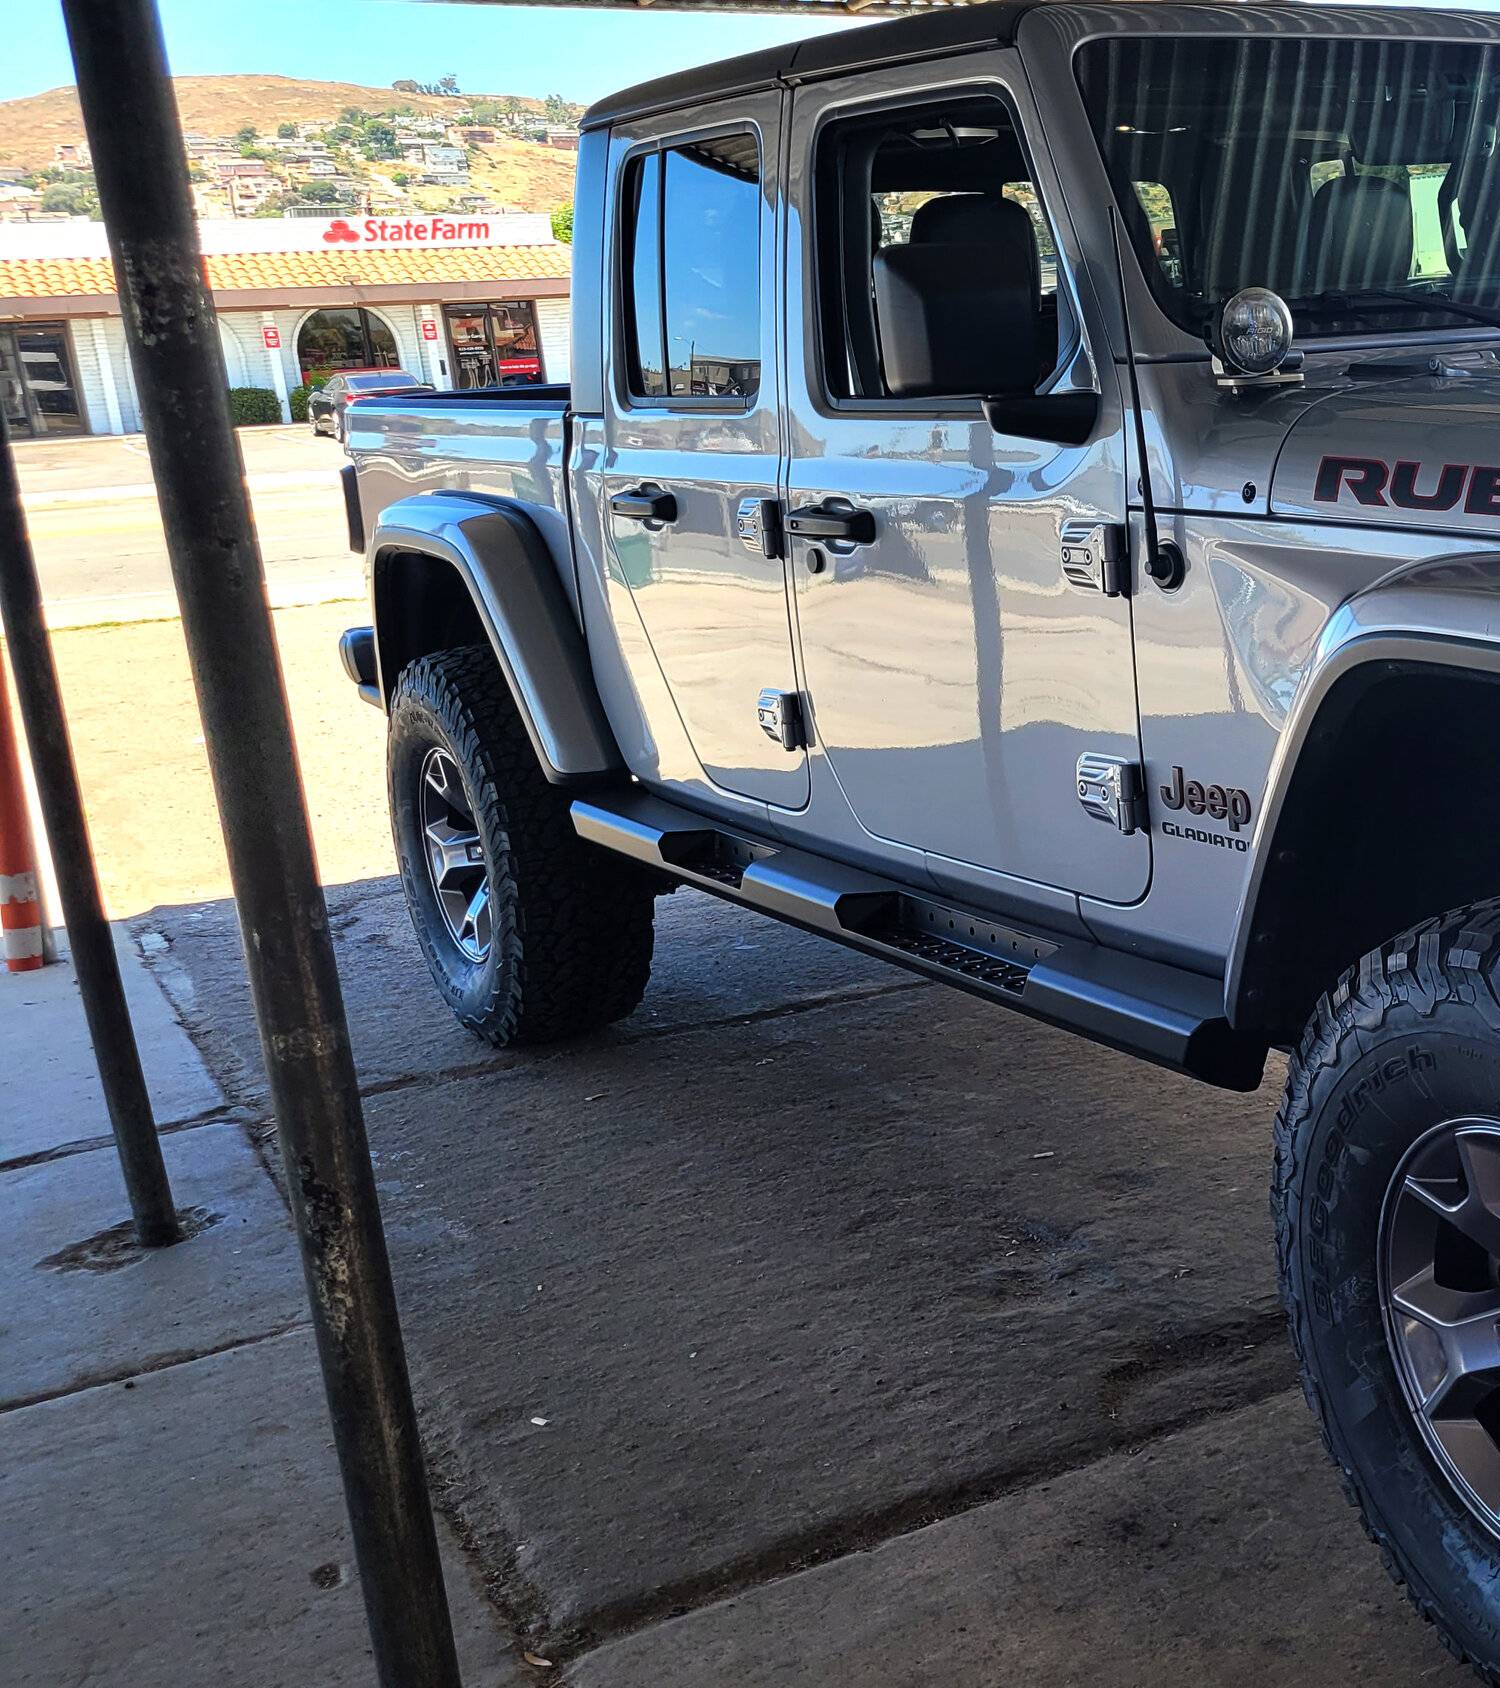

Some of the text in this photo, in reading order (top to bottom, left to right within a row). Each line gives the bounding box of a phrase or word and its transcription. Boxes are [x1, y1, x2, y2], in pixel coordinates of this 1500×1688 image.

[364, 218, 490, 242] State Farm
[1159, 765, 1252, 833] Jeep
[1161, 821, 1250, 853] GLADIATO
